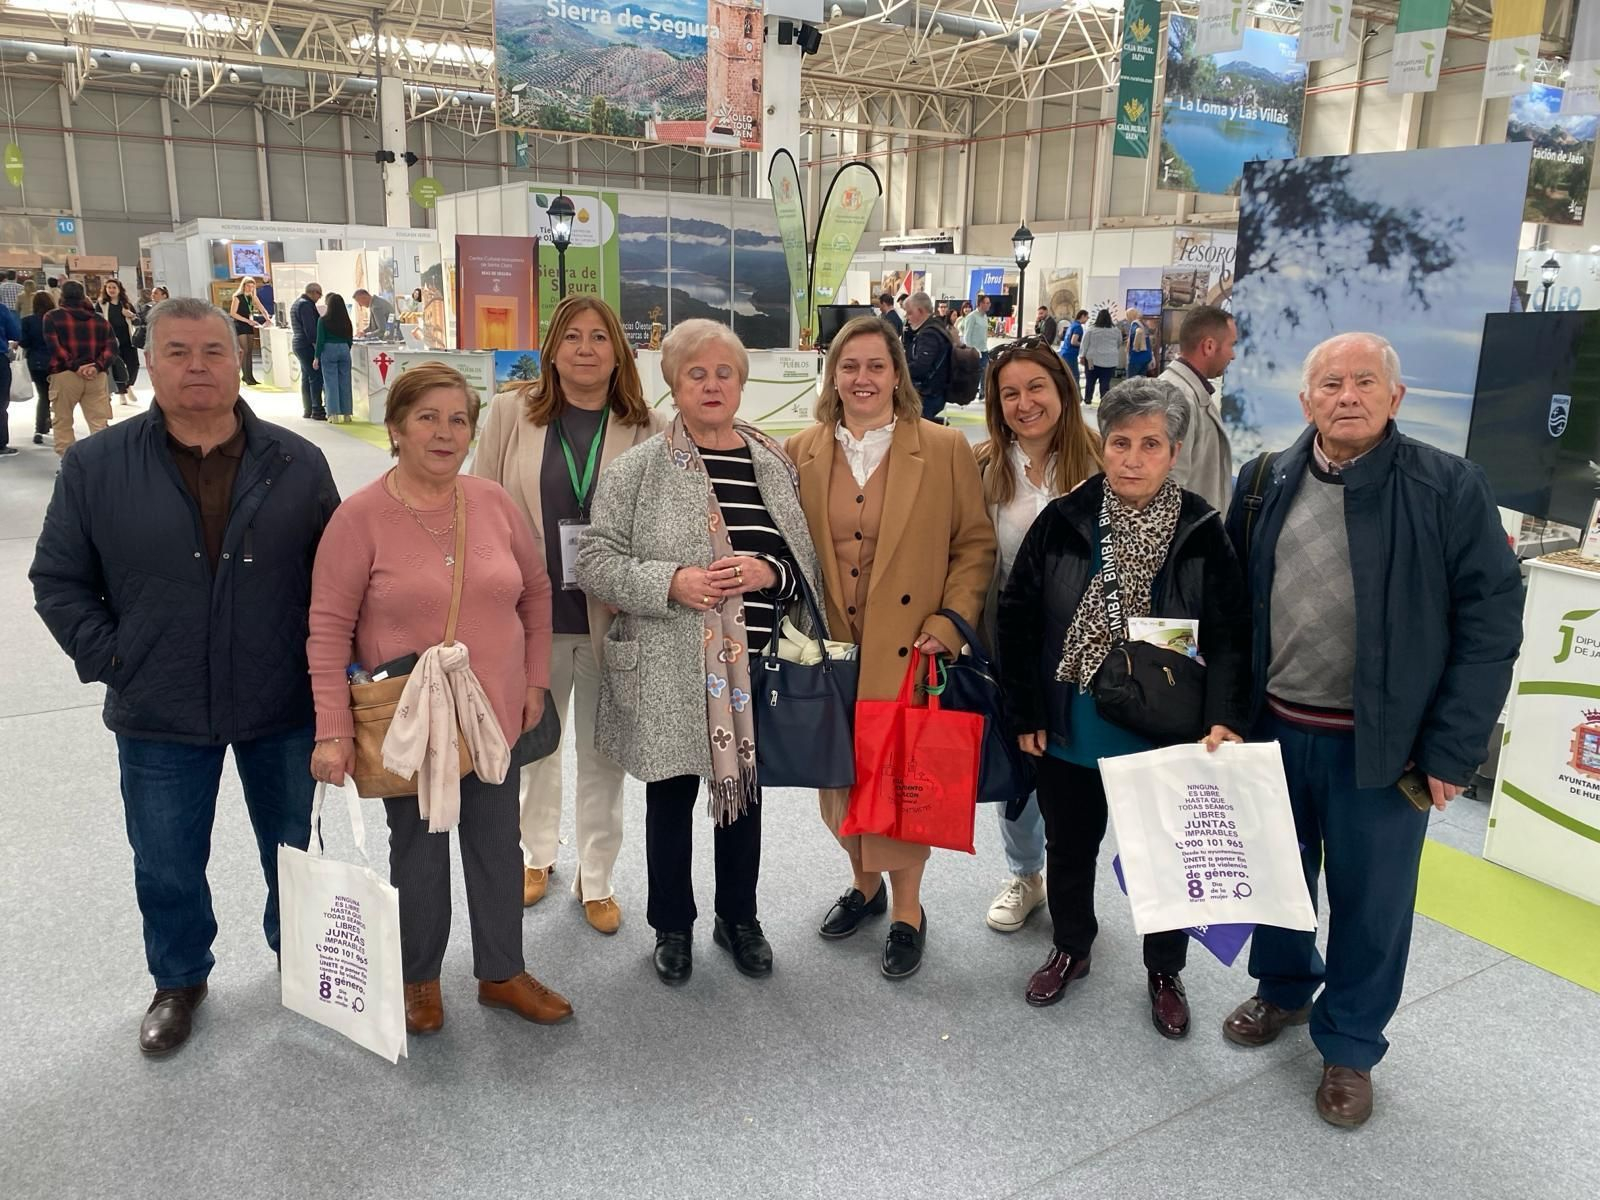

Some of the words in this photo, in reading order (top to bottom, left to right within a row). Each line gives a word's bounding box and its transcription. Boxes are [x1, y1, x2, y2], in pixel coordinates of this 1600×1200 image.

[547, 0, 611, 25] Sierra
[617, 8, 644, 29] de
[649, 12, 720, 40] Segura
[1180, 96, 1193, 111] La
[1196, 98, 1228, 117] Loma
[1229, 106, 1238, 121] y
[1239, 104, 1258, 120] Las
[1260, 107, 1289, 124] Villas
[732, 114, 753, 123] OLEO
[733, 122, 753, 130] TOUR
[1533, 148, 1557, 161] tación
[1557, 150, 1567, 162] de
[1567, 151, 1585, 165] Jaén
[59, 221, 74, 232] 10
[540, 226, 551, 234] Tie
[582, 266, 597, 279] de
[552, 279, 597, 295] Sgura
[1101, 533, 1116, 582] BIMBA
[1106, 589, 1122, 631] IMBA
[1576, 635, 1600, 648] DIPU
[1575, 646, 1589, 656] DE
[1558, 774, 1600, 791] AYUNTAM
[1570, 786, 1581, 796] DE
[1582, 791, 1600, 801] HUE
[1193, 811, 1226, 819] LIBRES
[1185, 820, 1236, 829] JUNTAS
[1185, 829, 1239, 838] IMPARABLES
[1207, 839, 1223, 847] 101
[1227, 839, 1244, 849] 965
[1186, 869, 1201, 879] de
[1204, 868, 1249, 880] género.
[1188, 880, 1204, 899] 8
[335, 895, 360, 907] NINGUNA
[331, 907, 352, 916] HASTA
[345, 903, 360, 913] LIBRE
[323, 912, 346, 921] TODAS
[347, 916, 366, 929] SEAMOS
[335, 921, 361, 934] LIBRES
[326, 929, 365, 947] JUNTAS
[325, 936, 365, 955] IMPARABLES
[323, 945, 339, 954] 900
[342, 948, 354, 959] 101
[356, 954, 368, 965] 965
[345, 967, 360, 976] poner
[320, 971, 332, 982] de
[334, 976, 366, 995] género.
[320, 981, 332, 1000] 8
